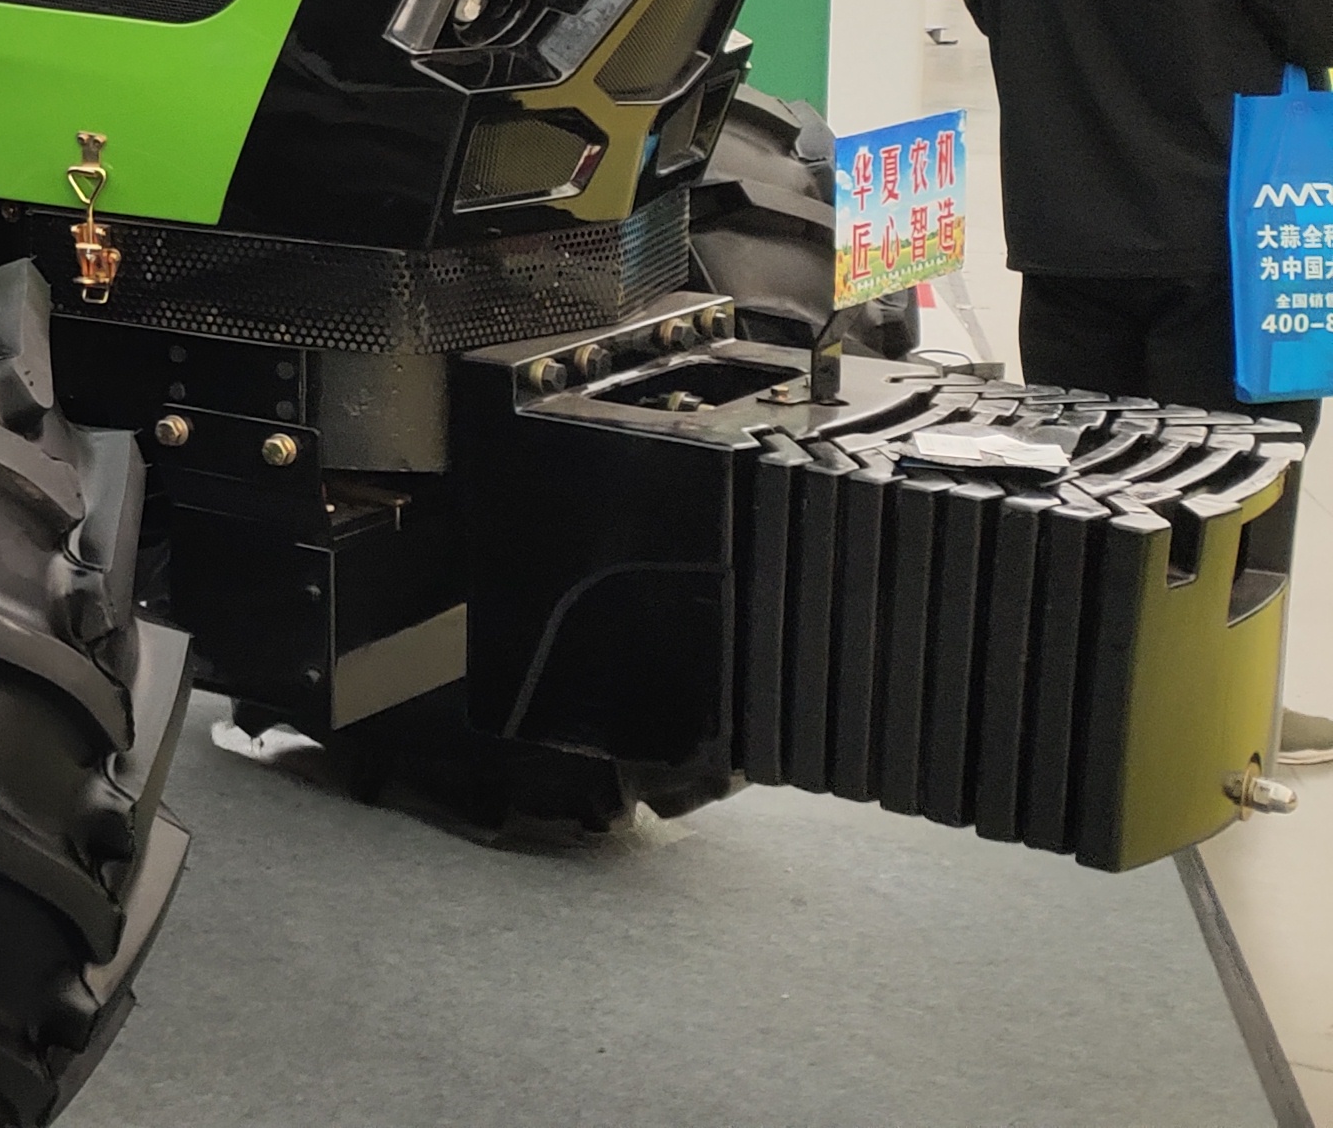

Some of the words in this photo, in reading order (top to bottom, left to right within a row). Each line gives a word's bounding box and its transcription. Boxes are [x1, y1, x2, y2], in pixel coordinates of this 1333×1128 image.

[851, 129, 956, 213] 华夏农机
[850, 197, 957, 282] 匠心智造
